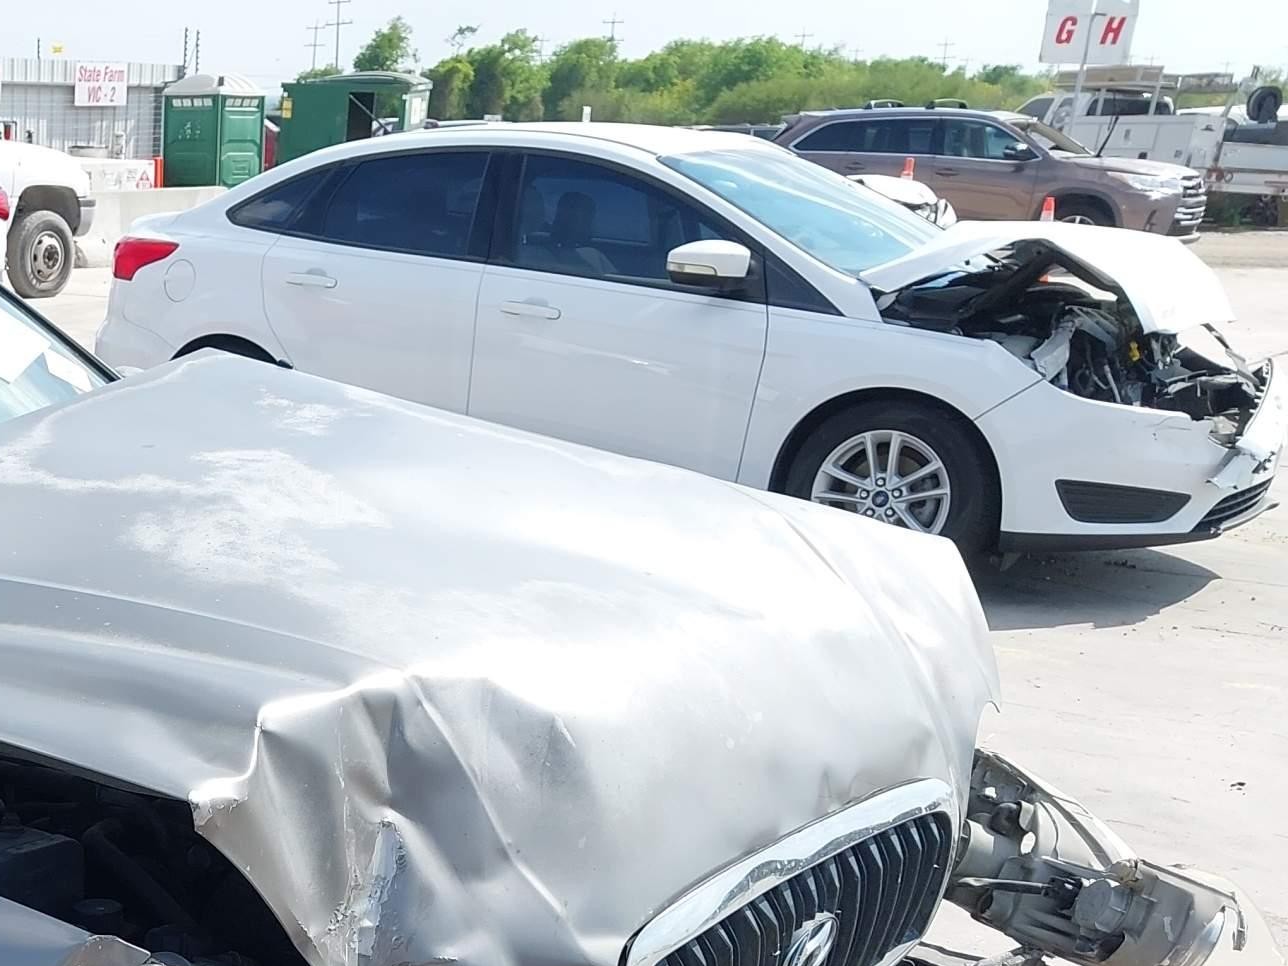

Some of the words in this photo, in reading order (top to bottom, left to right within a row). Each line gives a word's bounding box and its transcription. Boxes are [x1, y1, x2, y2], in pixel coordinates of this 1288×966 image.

[1055, 16, 1078, 44] G
[1099, 16, 1127, 45] H
[78, 65, 102, 82] State
[103, 65, 125, 82] Farm
[87, 87, 102, 103] VIC
[109, 87, 116, 103] 2
